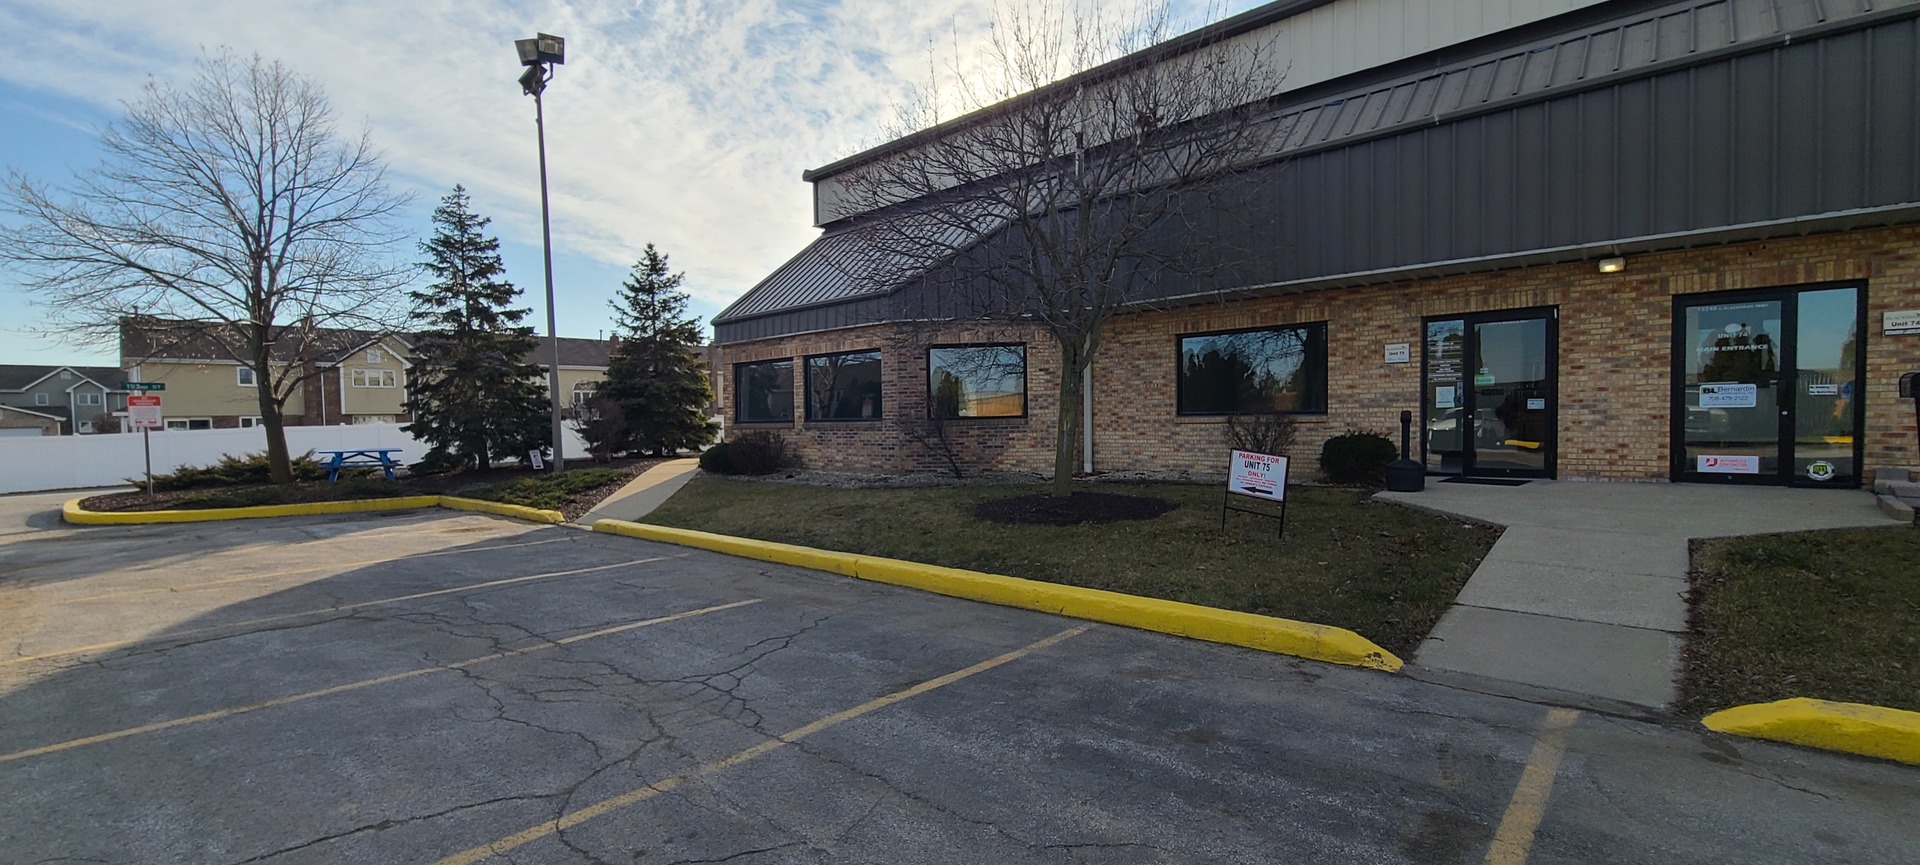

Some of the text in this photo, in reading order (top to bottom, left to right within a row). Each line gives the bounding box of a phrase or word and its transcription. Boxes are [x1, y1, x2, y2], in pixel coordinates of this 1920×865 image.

[1696, 344, 1769, 353] MAIN ENTRANCE
[1238, 452, 1280, 464] PARKING FOR
[1244, 460, 1271, 471] UNIT 75
